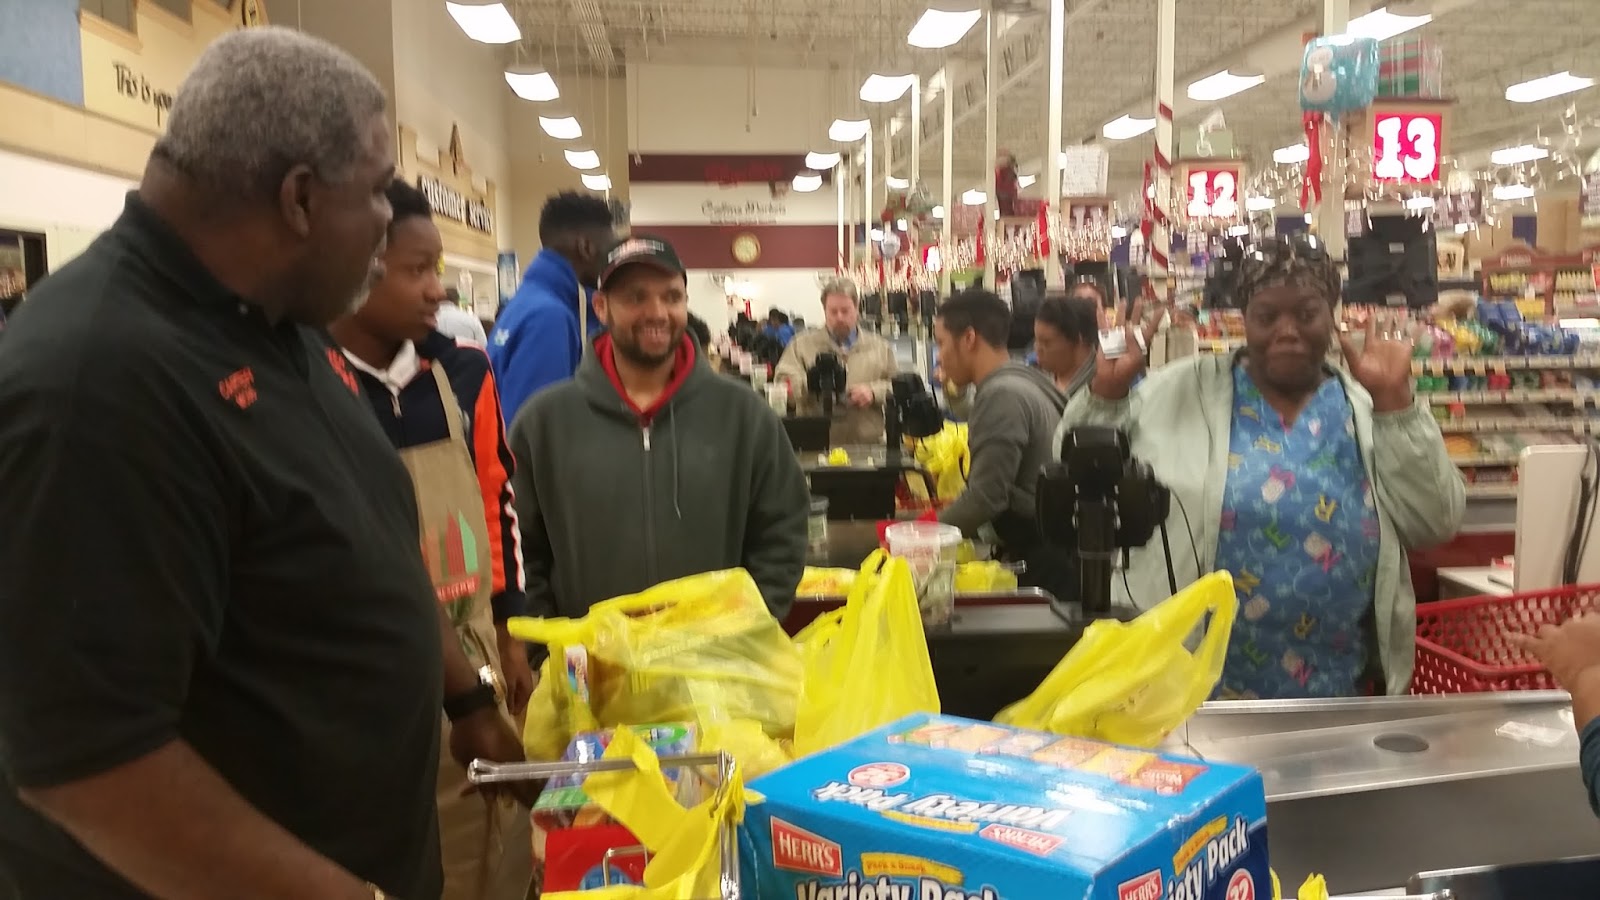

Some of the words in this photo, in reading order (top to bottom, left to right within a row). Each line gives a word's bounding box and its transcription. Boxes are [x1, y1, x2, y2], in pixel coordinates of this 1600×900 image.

[1375, 116, 1437, 180] 13
[1187, 170, 1237, 218] 12
[778, 830, 835, 870] HERR'S
[1206, 816, 1249, 882] Pack
